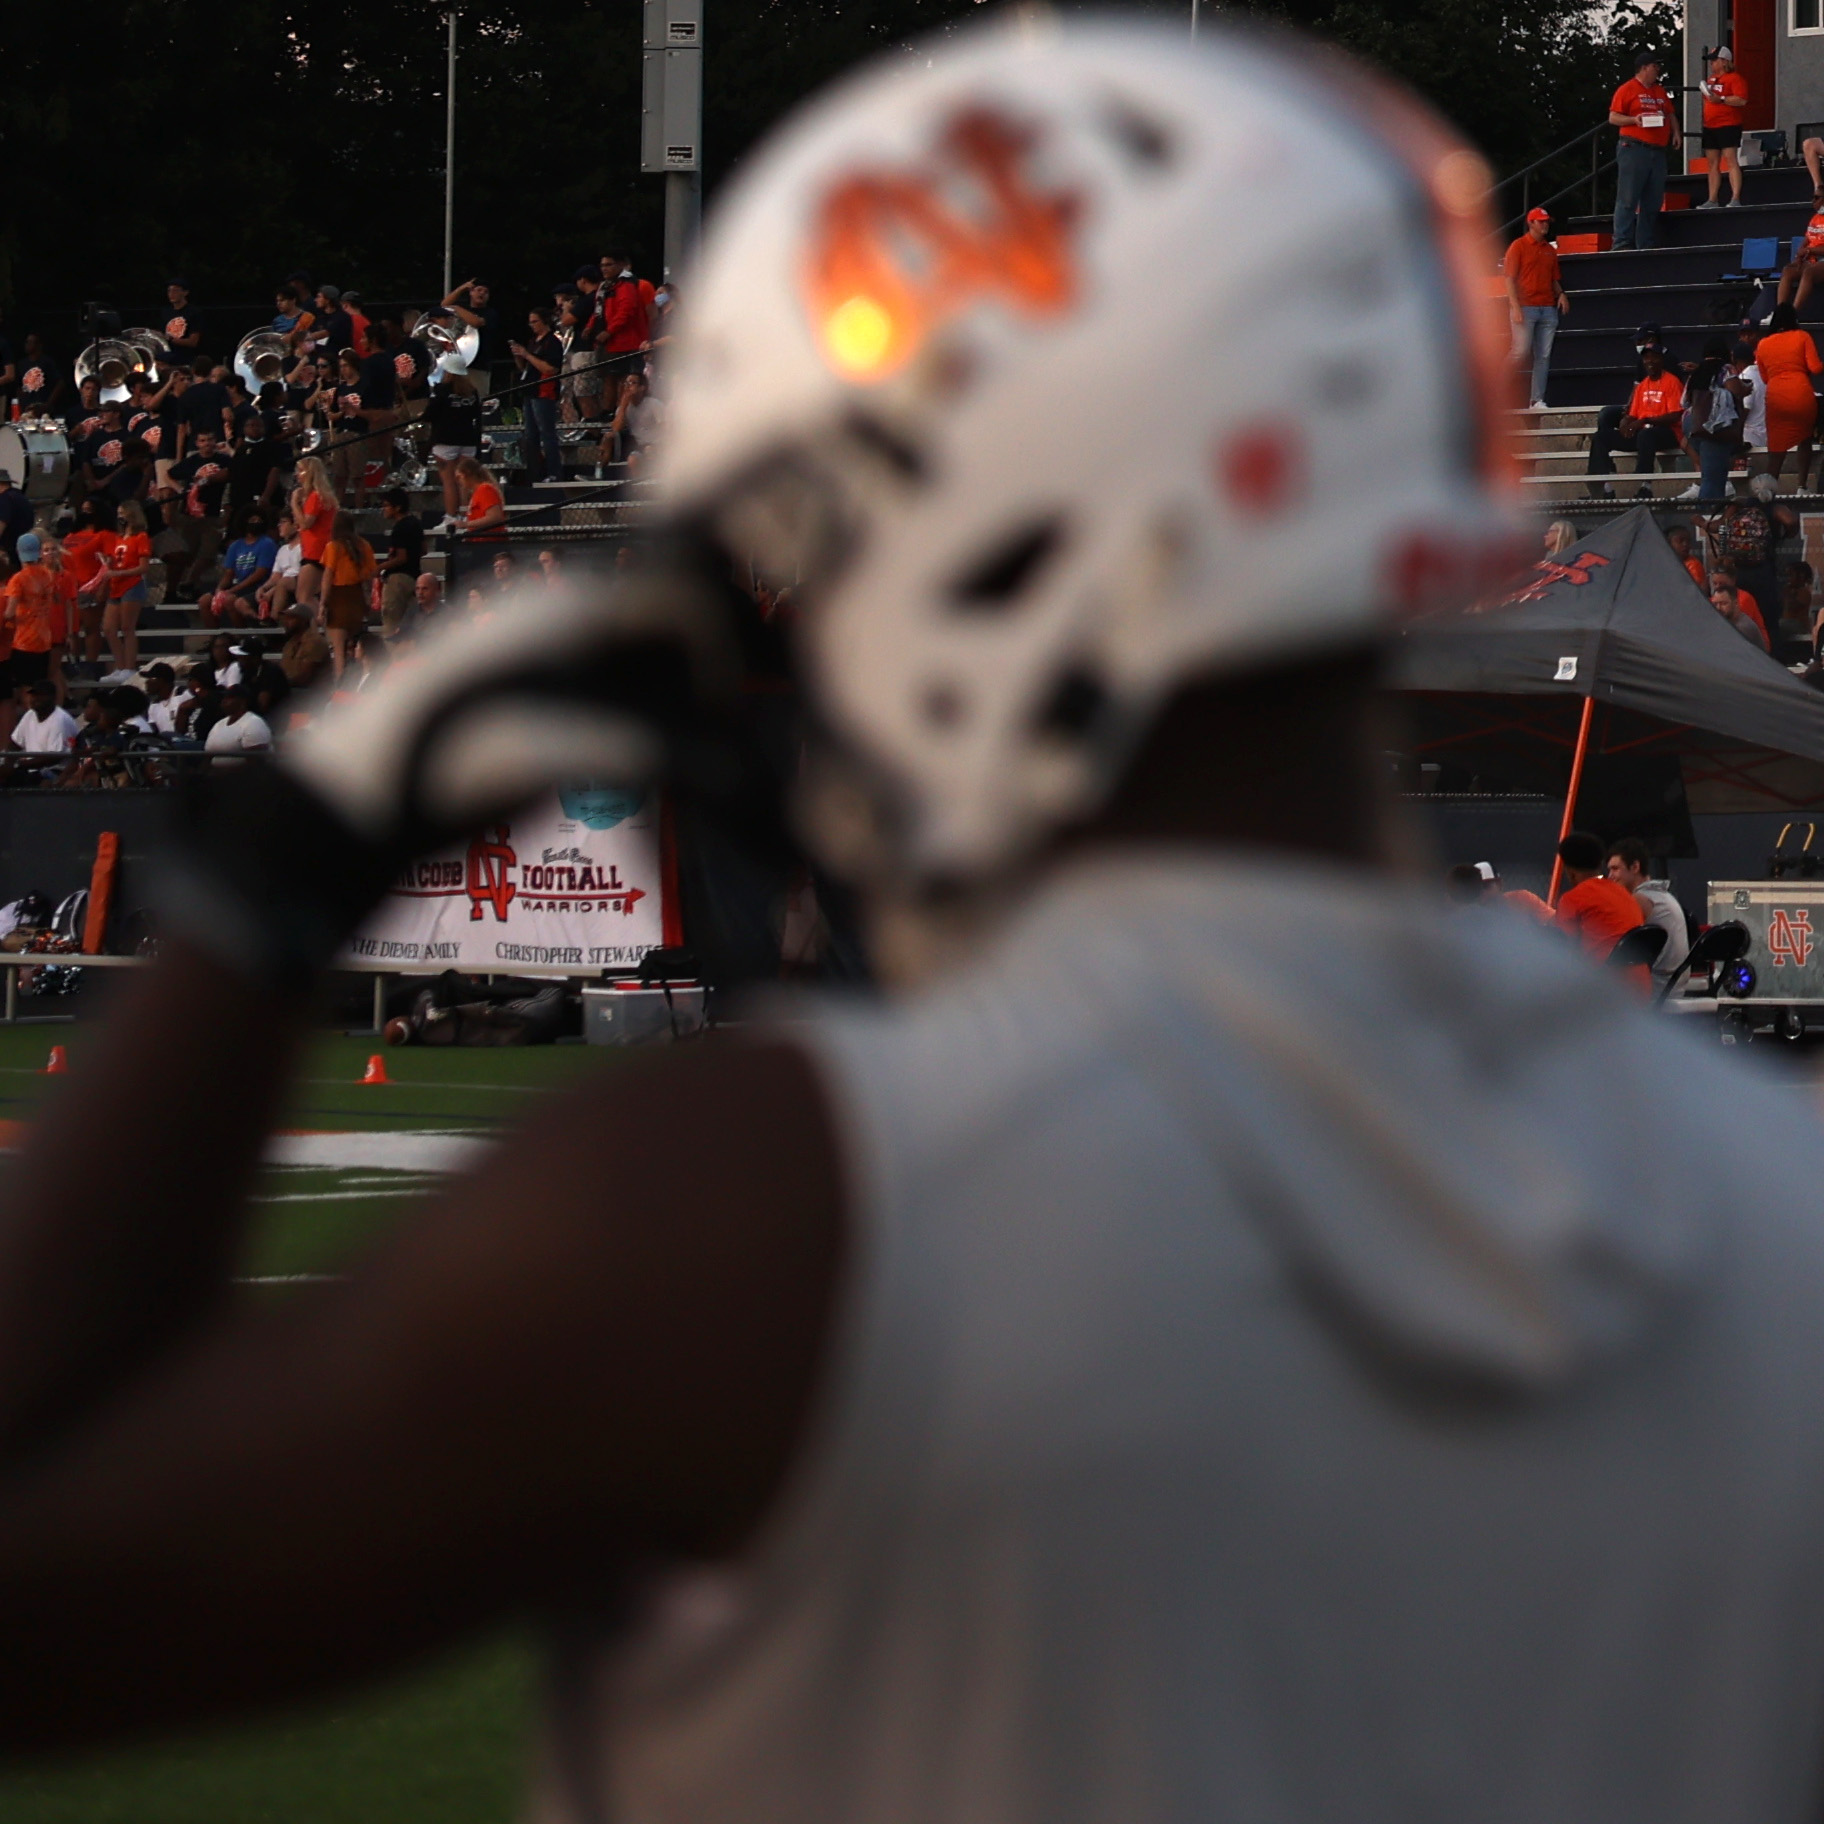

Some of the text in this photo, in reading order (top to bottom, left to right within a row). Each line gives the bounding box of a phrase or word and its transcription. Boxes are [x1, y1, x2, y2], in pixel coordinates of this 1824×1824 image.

[522, 864, 622, 890] FOOTBALL
[521, 899, 621, 913] WARRIORS
[421, 941, 462, 959] AMILY
[496, 941, 582, 965] CHRISTOPHER
